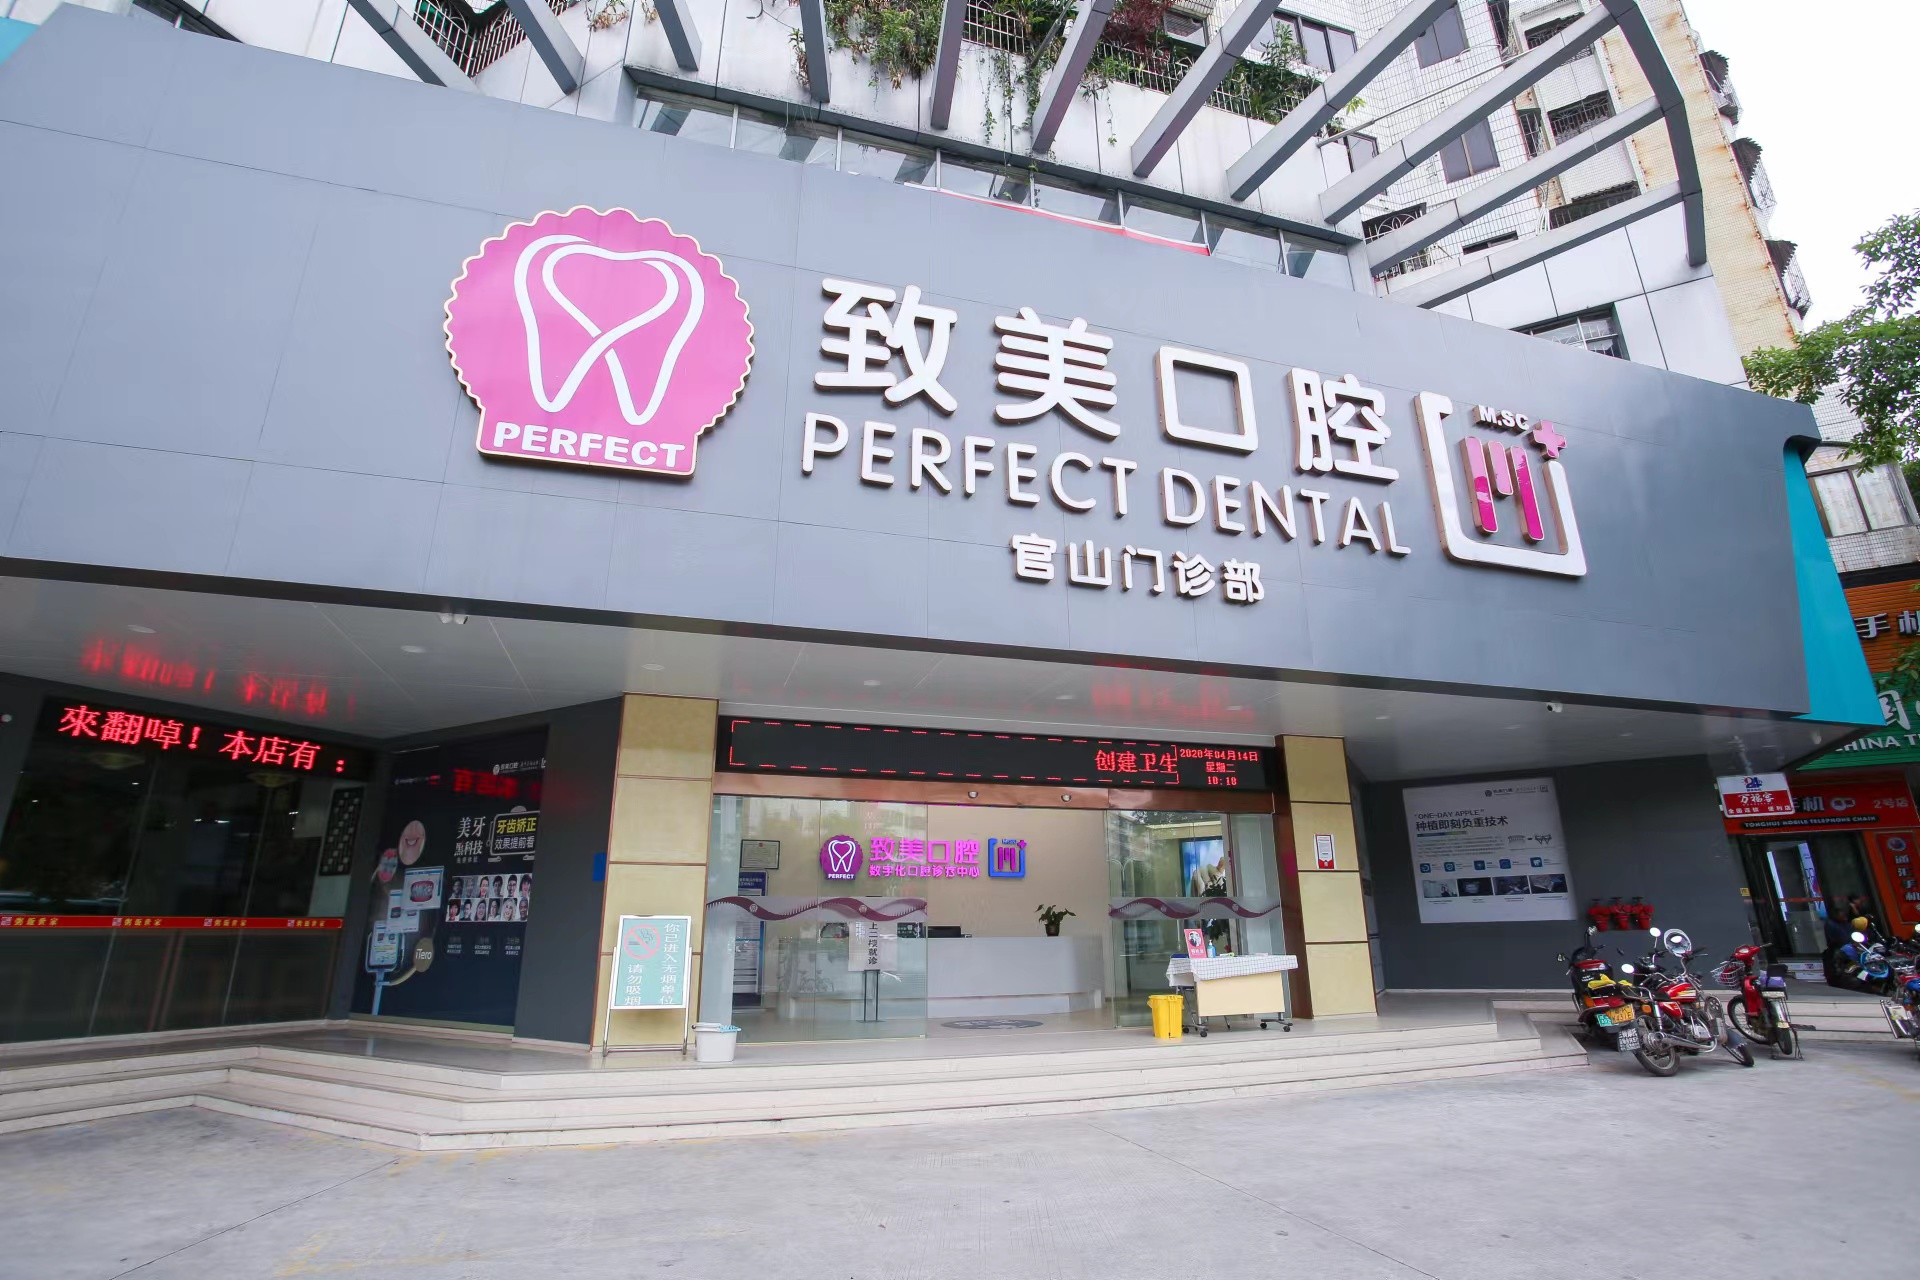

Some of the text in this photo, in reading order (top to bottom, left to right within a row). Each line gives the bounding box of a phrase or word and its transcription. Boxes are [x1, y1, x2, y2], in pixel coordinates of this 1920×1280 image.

[813, 277, 1399, 484] 致美口腔
[1475, 404, 1530, 432] M.SC
[493, 421, 686, 468] PERFECT
[801, 411, 1411, 556] PERFECT DENTAL
[1010, 532, 1265, 604] 官山门诊部
[1095, 749, 1178, 773] 创建卫生
[1180, 748, 1259, 762] 2020年04月14日
[1205, 761, 1236, 773] 星期二
[456, 816, 487, 839] 美牙
[496, 817, 537, 834] 牙齿矫正
[1415, 815, 1509, 832] 种植即刻负重技术
[454, 840, 483, 856] 黑科技
[494, 835, 535, 850] 效果提前看
[869, 837, 981, 864] 致美口腔
[869, 864, 981, 878] 数字化口腔诊疗中心
[660, 923, 680, 1005] 你已进入无烟单位
[625, 964, 643, 1005] 请勿吸烟
